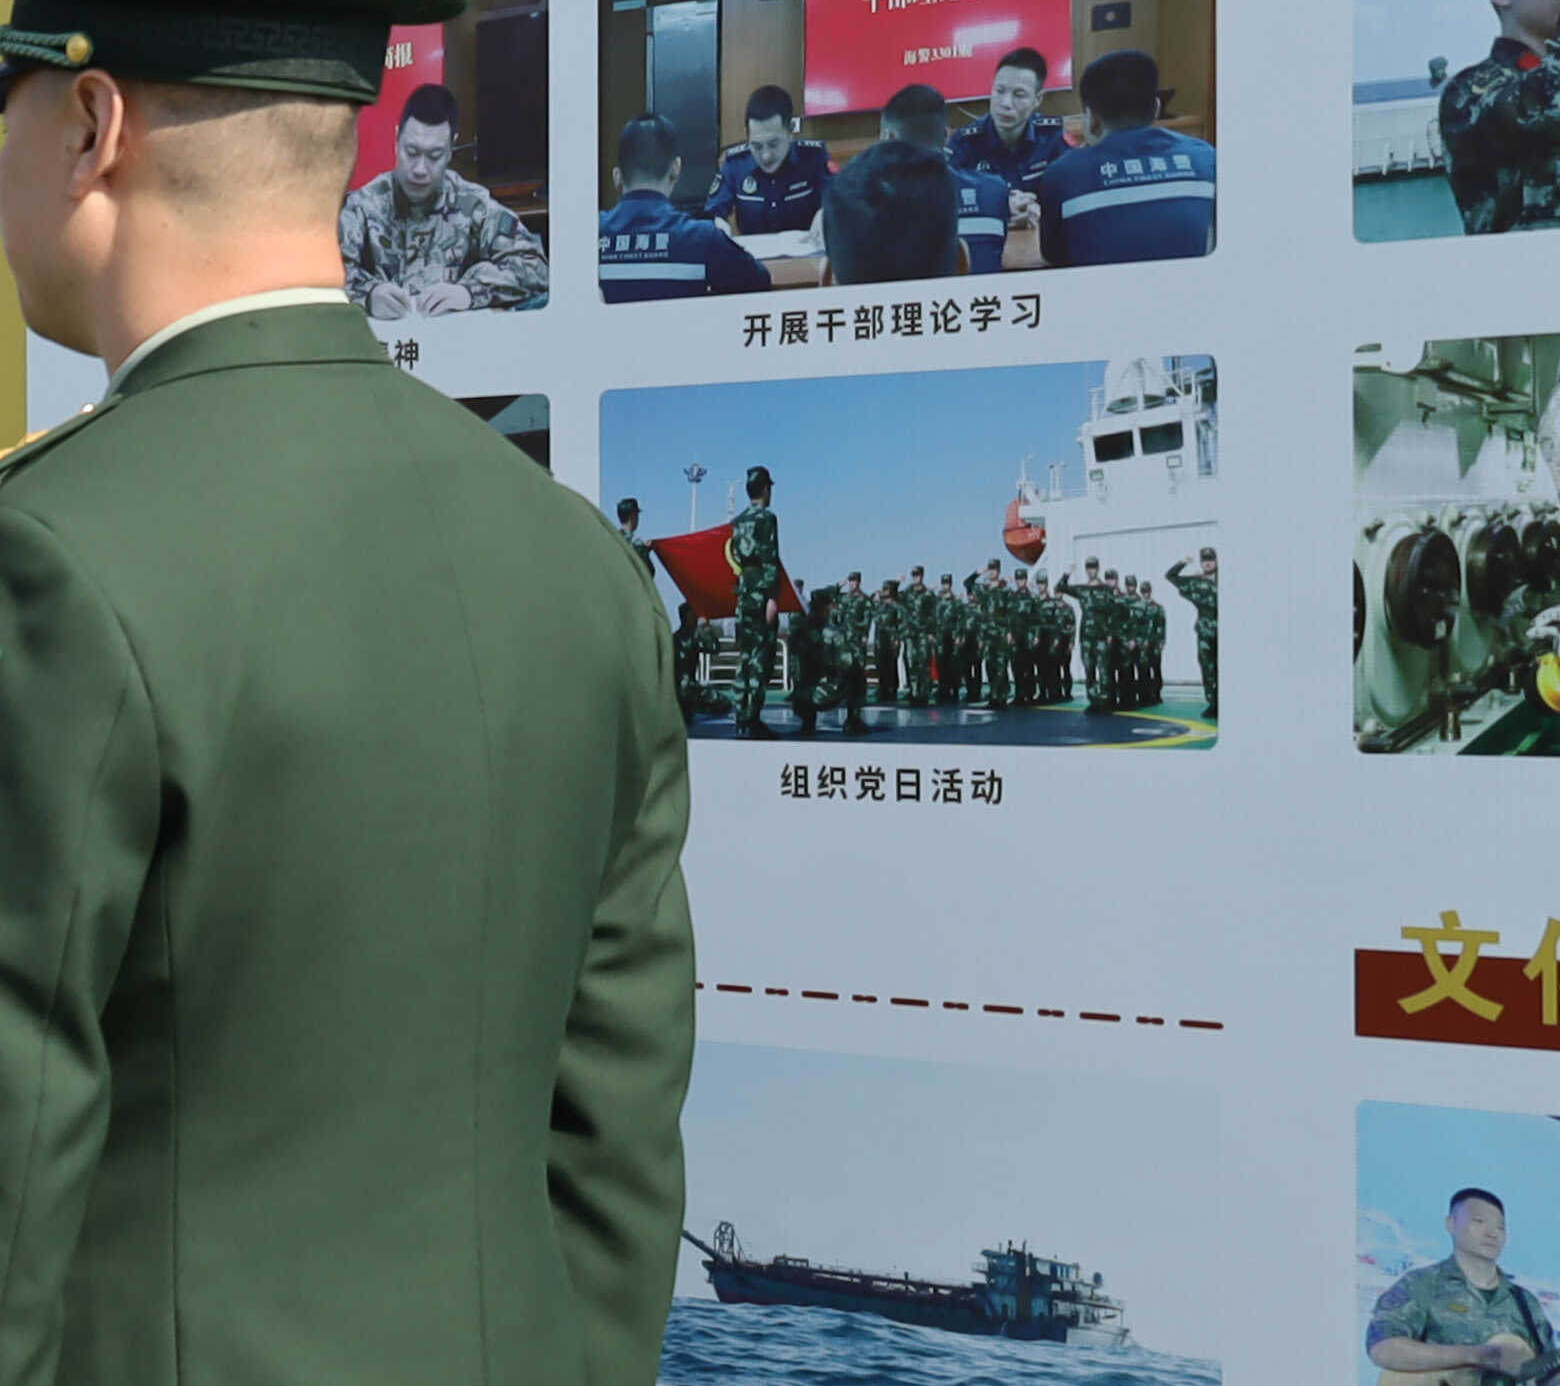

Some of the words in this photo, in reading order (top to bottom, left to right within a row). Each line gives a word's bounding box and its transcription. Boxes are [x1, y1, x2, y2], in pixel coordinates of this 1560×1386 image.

[742, 293, 1042, 348] 开展干部理论学习
[779, 763, 1005, 806] 组织党日活动
